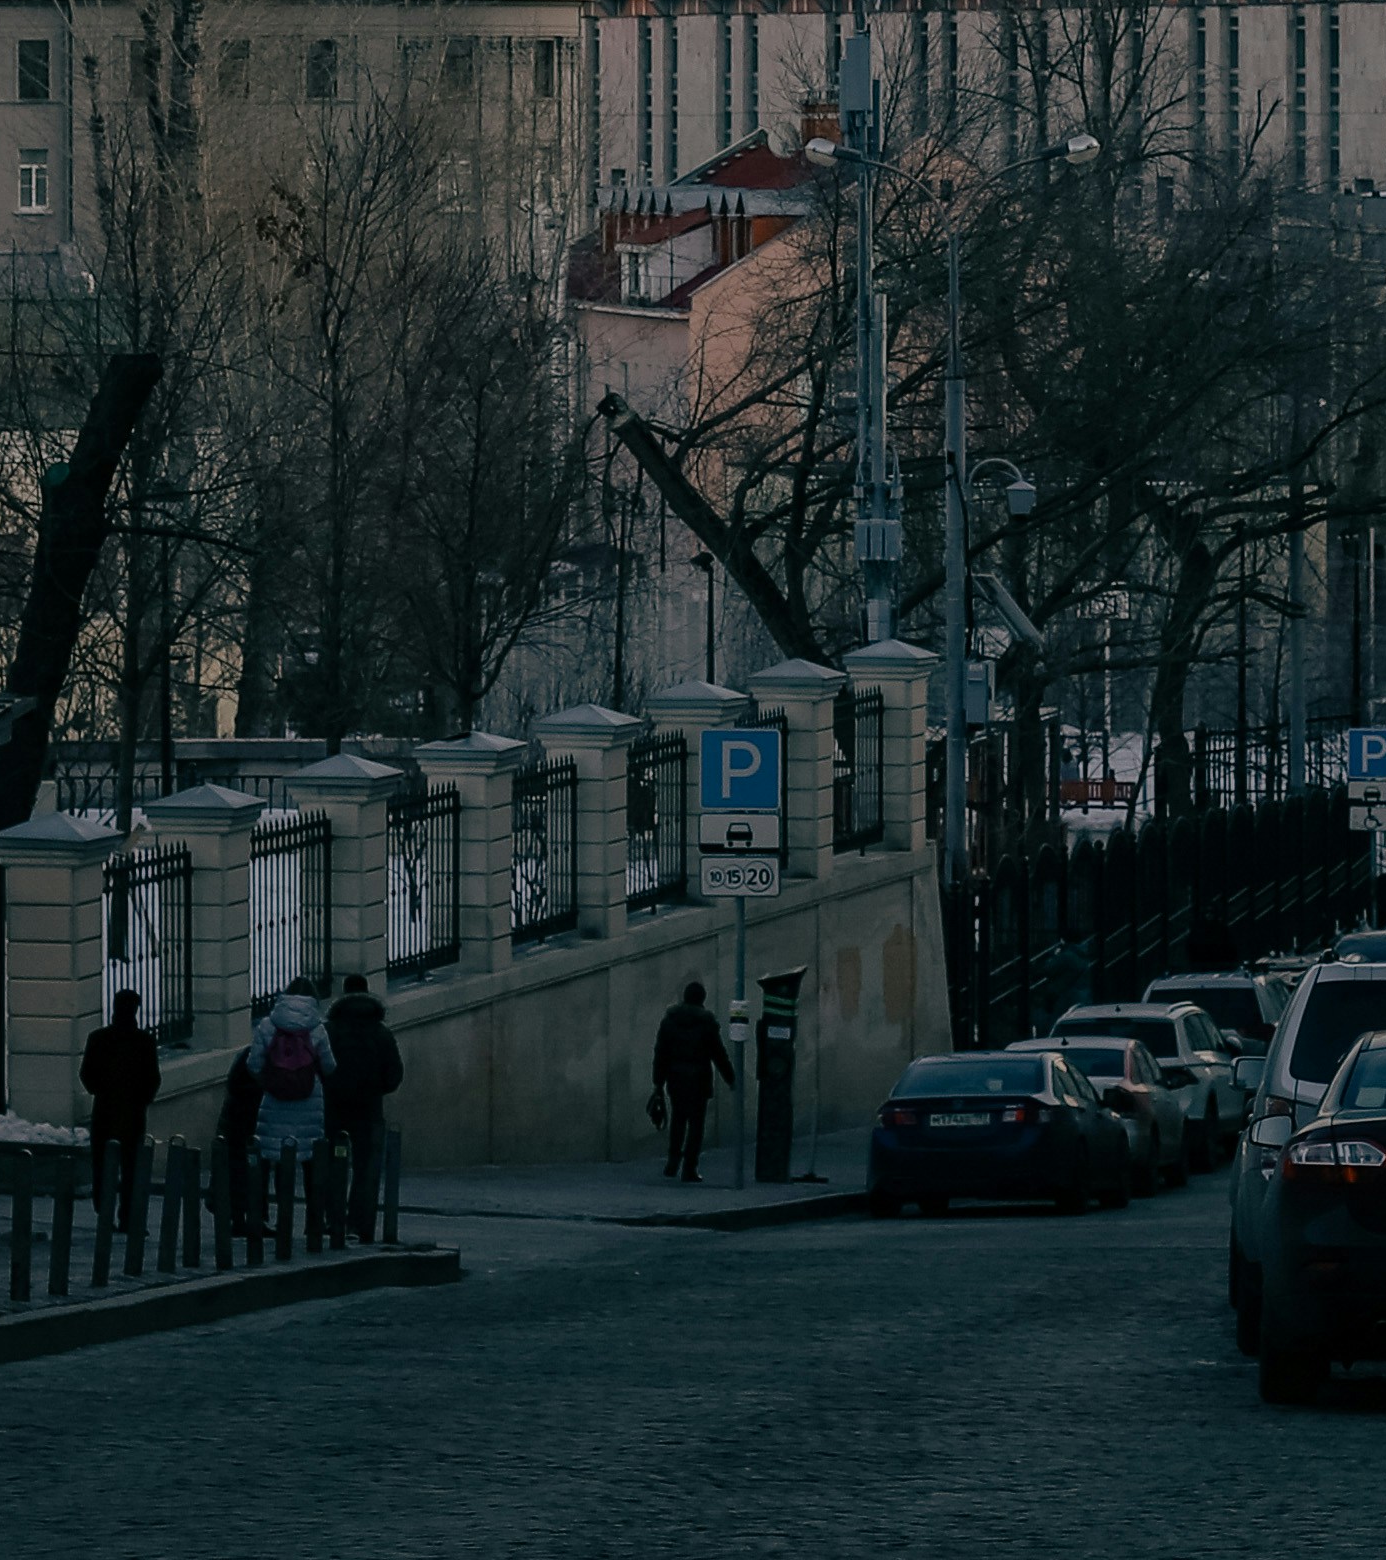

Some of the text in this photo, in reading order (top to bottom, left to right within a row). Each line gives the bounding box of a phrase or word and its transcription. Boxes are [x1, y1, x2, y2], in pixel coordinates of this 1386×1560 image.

[721, 740, 762, 799] P
[710, 868, 770, 885] 10 15 20
